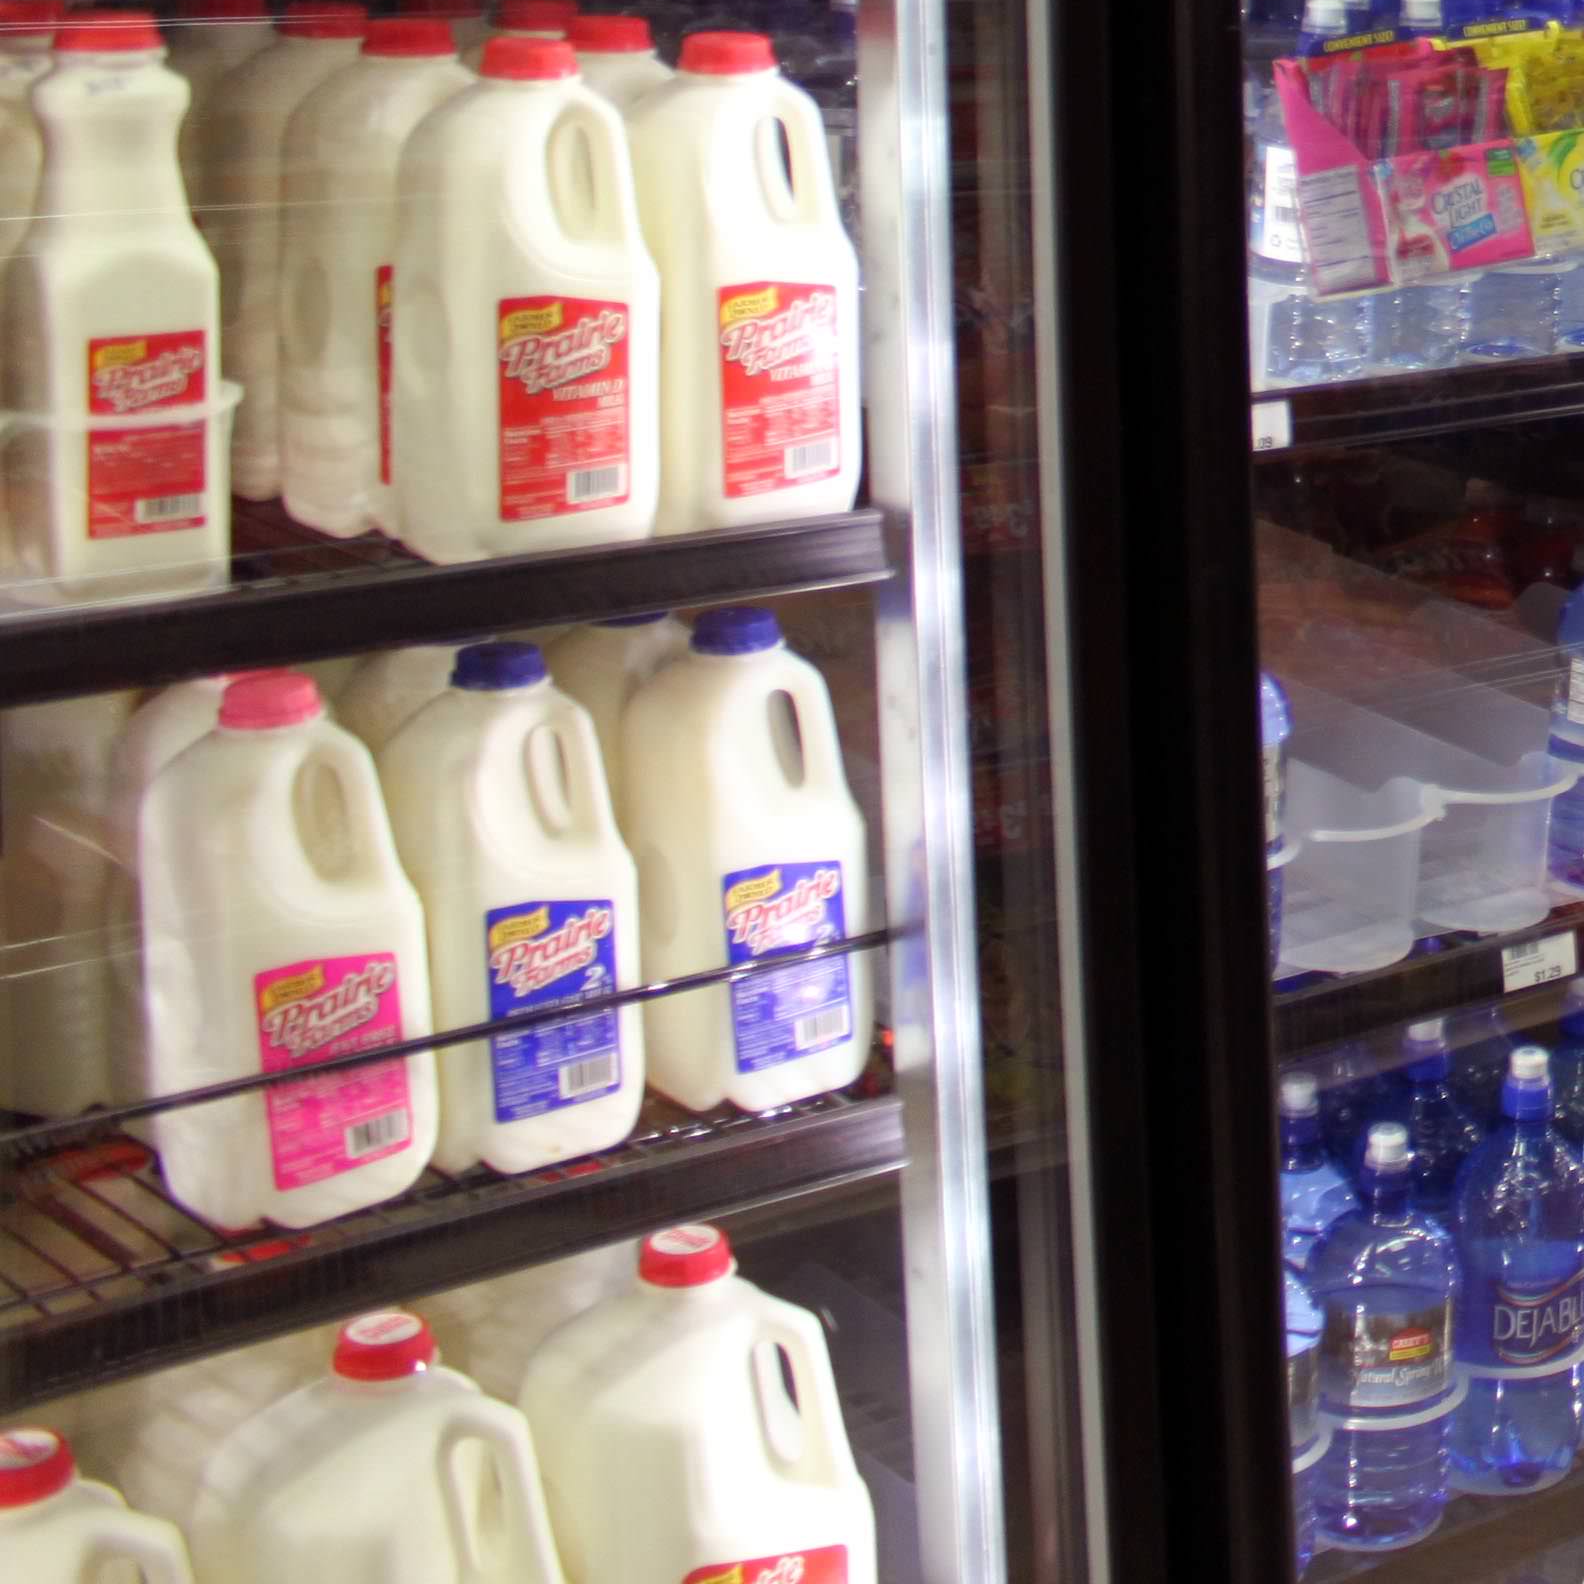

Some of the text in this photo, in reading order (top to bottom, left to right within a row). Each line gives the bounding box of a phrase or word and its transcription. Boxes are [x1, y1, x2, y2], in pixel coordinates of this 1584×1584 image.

[500, 309, 626, 379] Prairie
[726, 868, 841, 944] Prairie
[490, 906, 612, 985] Prairie
[511, 943, 597, 997] Farms
[1533, 965, 1571, 982] $1.29
[262, 961, 396, 1047] Prairie
